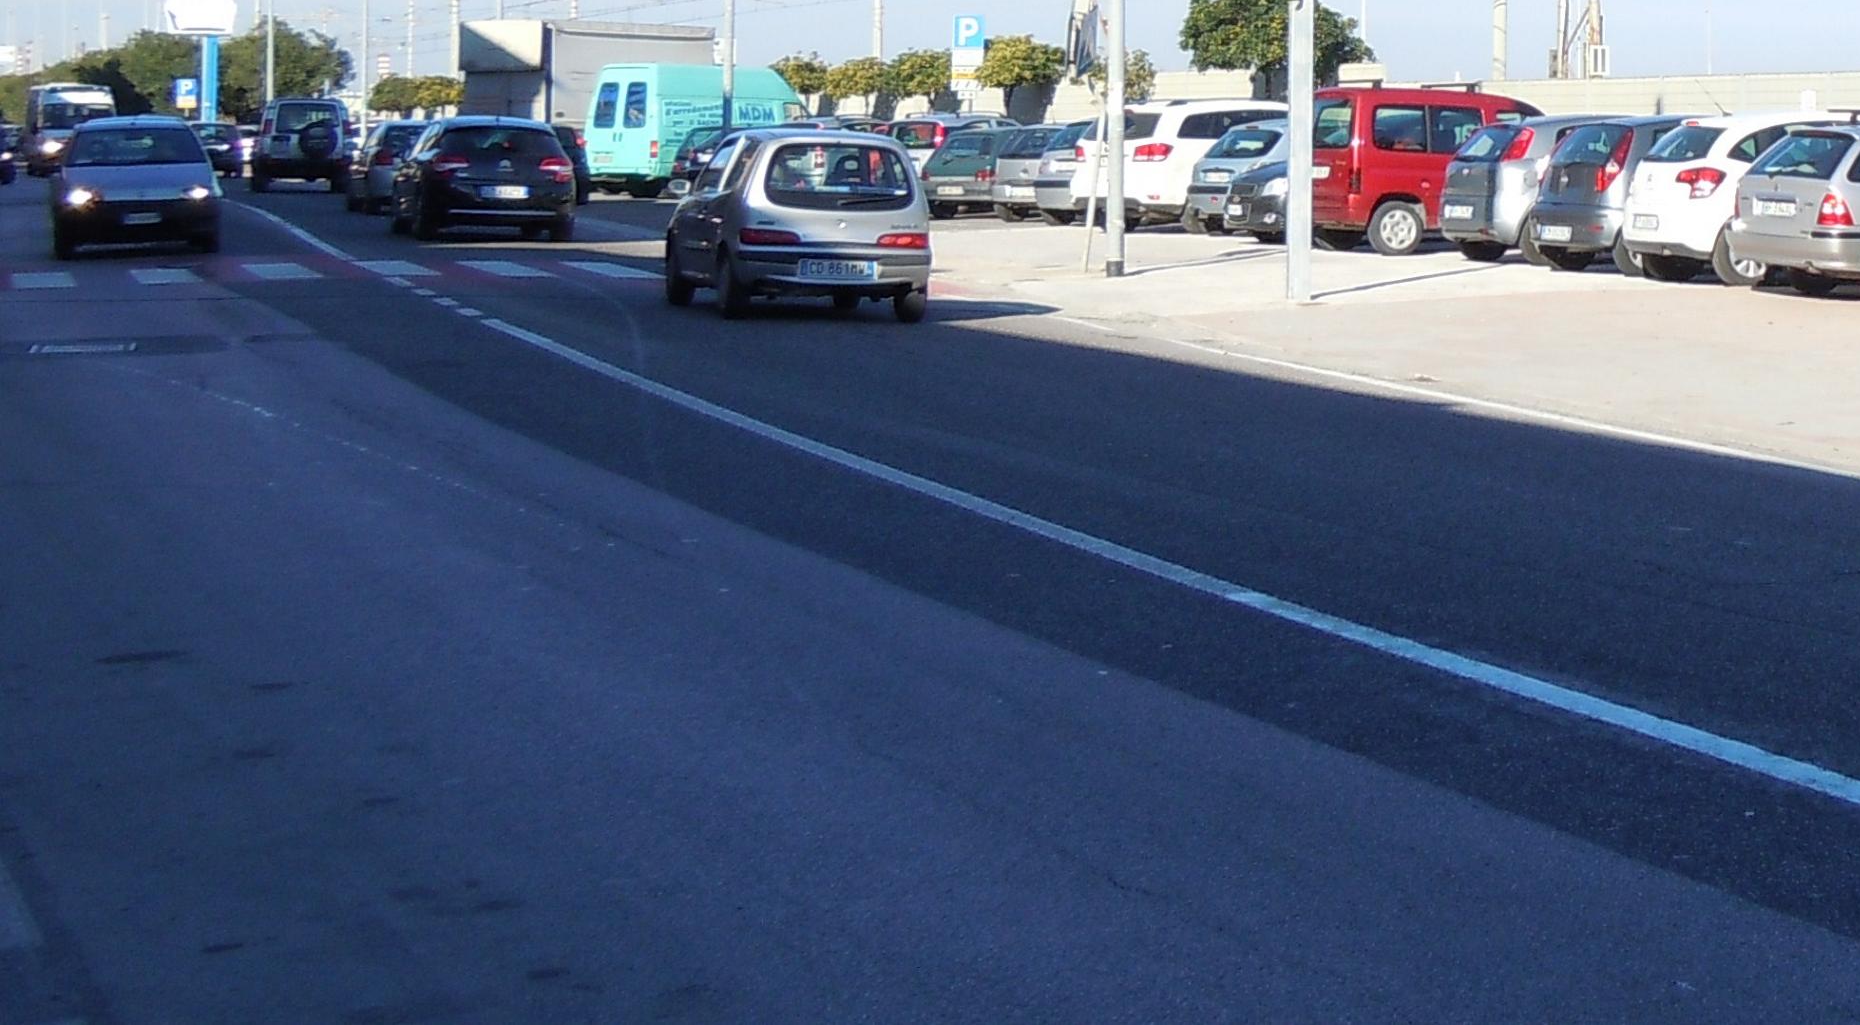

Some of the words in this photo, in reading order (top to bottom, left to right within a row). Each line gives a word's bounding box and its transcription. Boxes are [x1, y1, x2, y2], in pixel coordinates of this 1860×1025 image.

[958, 17, 979, 46] P
[180, 79, 193, 95] P
[738, 106, 775, 122] MDM
